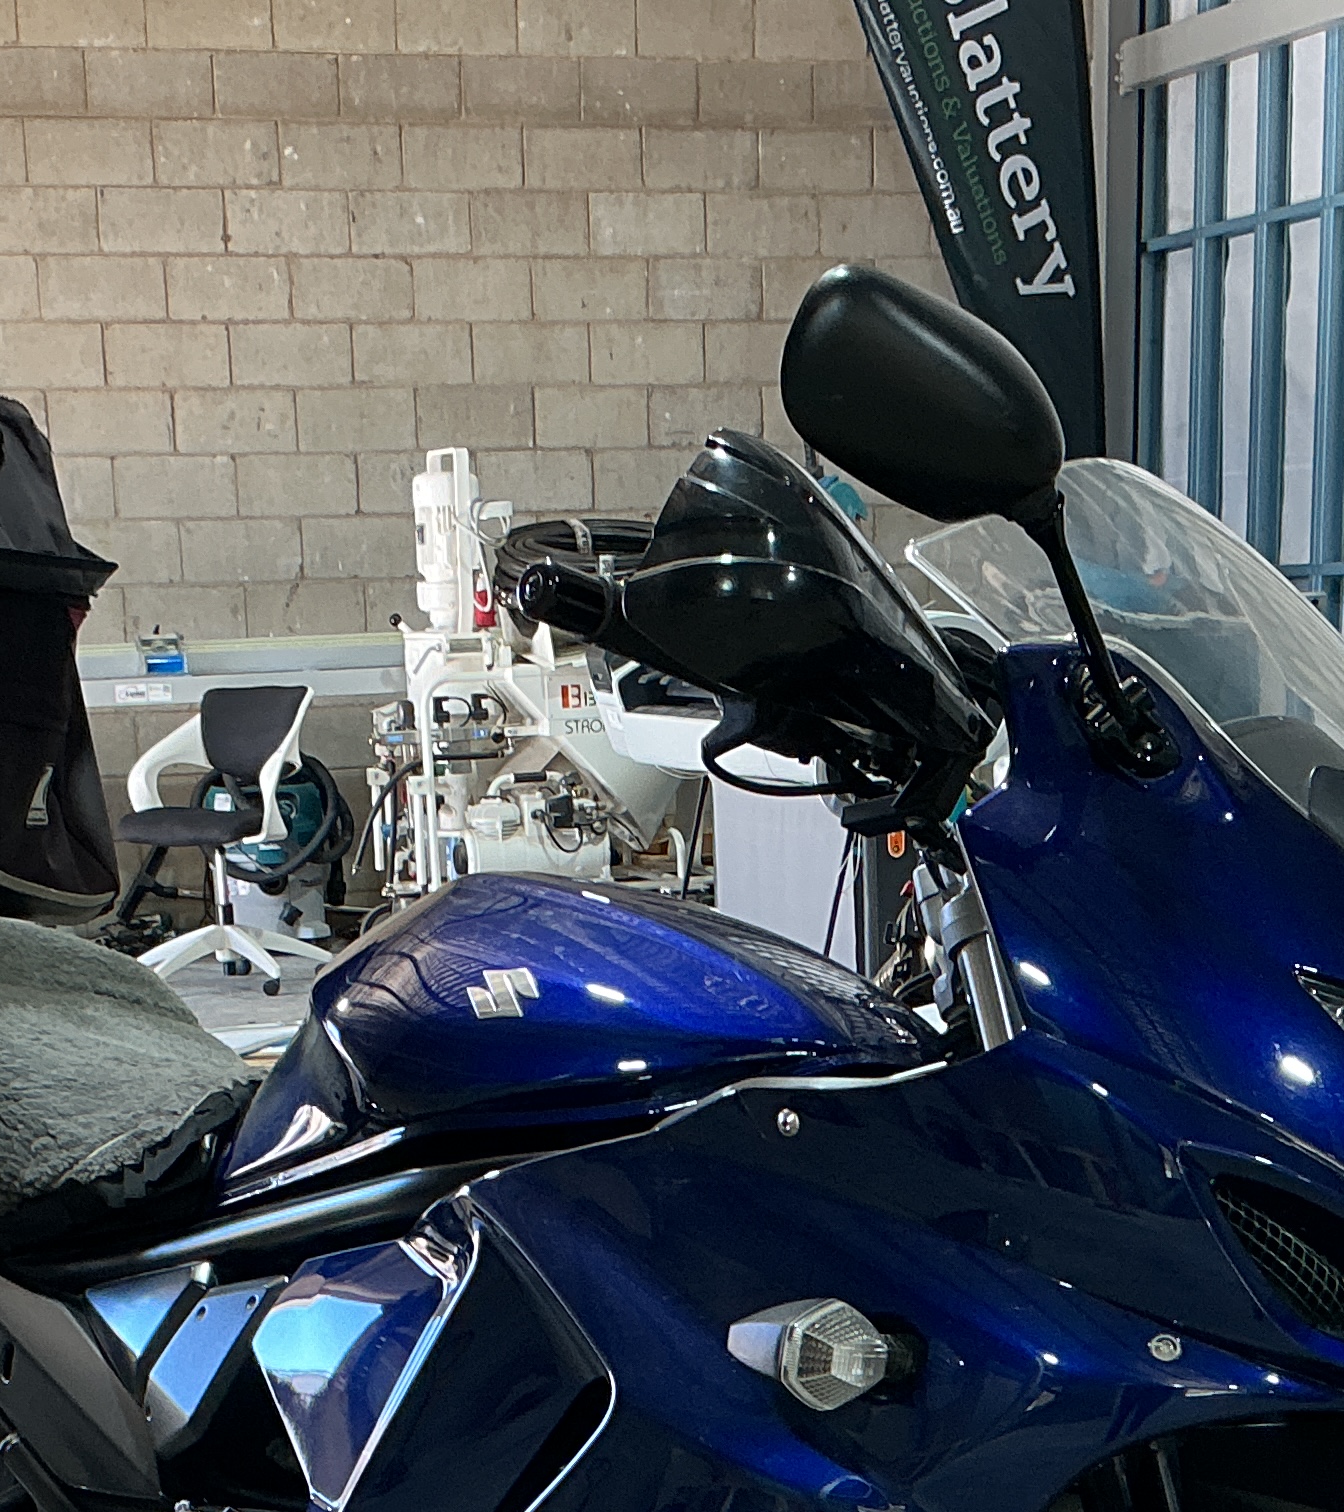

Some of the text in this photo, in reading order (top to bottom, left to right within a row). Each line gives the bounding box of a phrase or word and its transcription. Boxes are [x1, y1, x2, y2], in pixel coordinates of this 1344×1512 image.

[942, 96, 961, 120] &
[953, 121, 1006, 266] Valuations
[944, 0, 1076, 298] lattery
[565, 718, 606, 735] STRO
